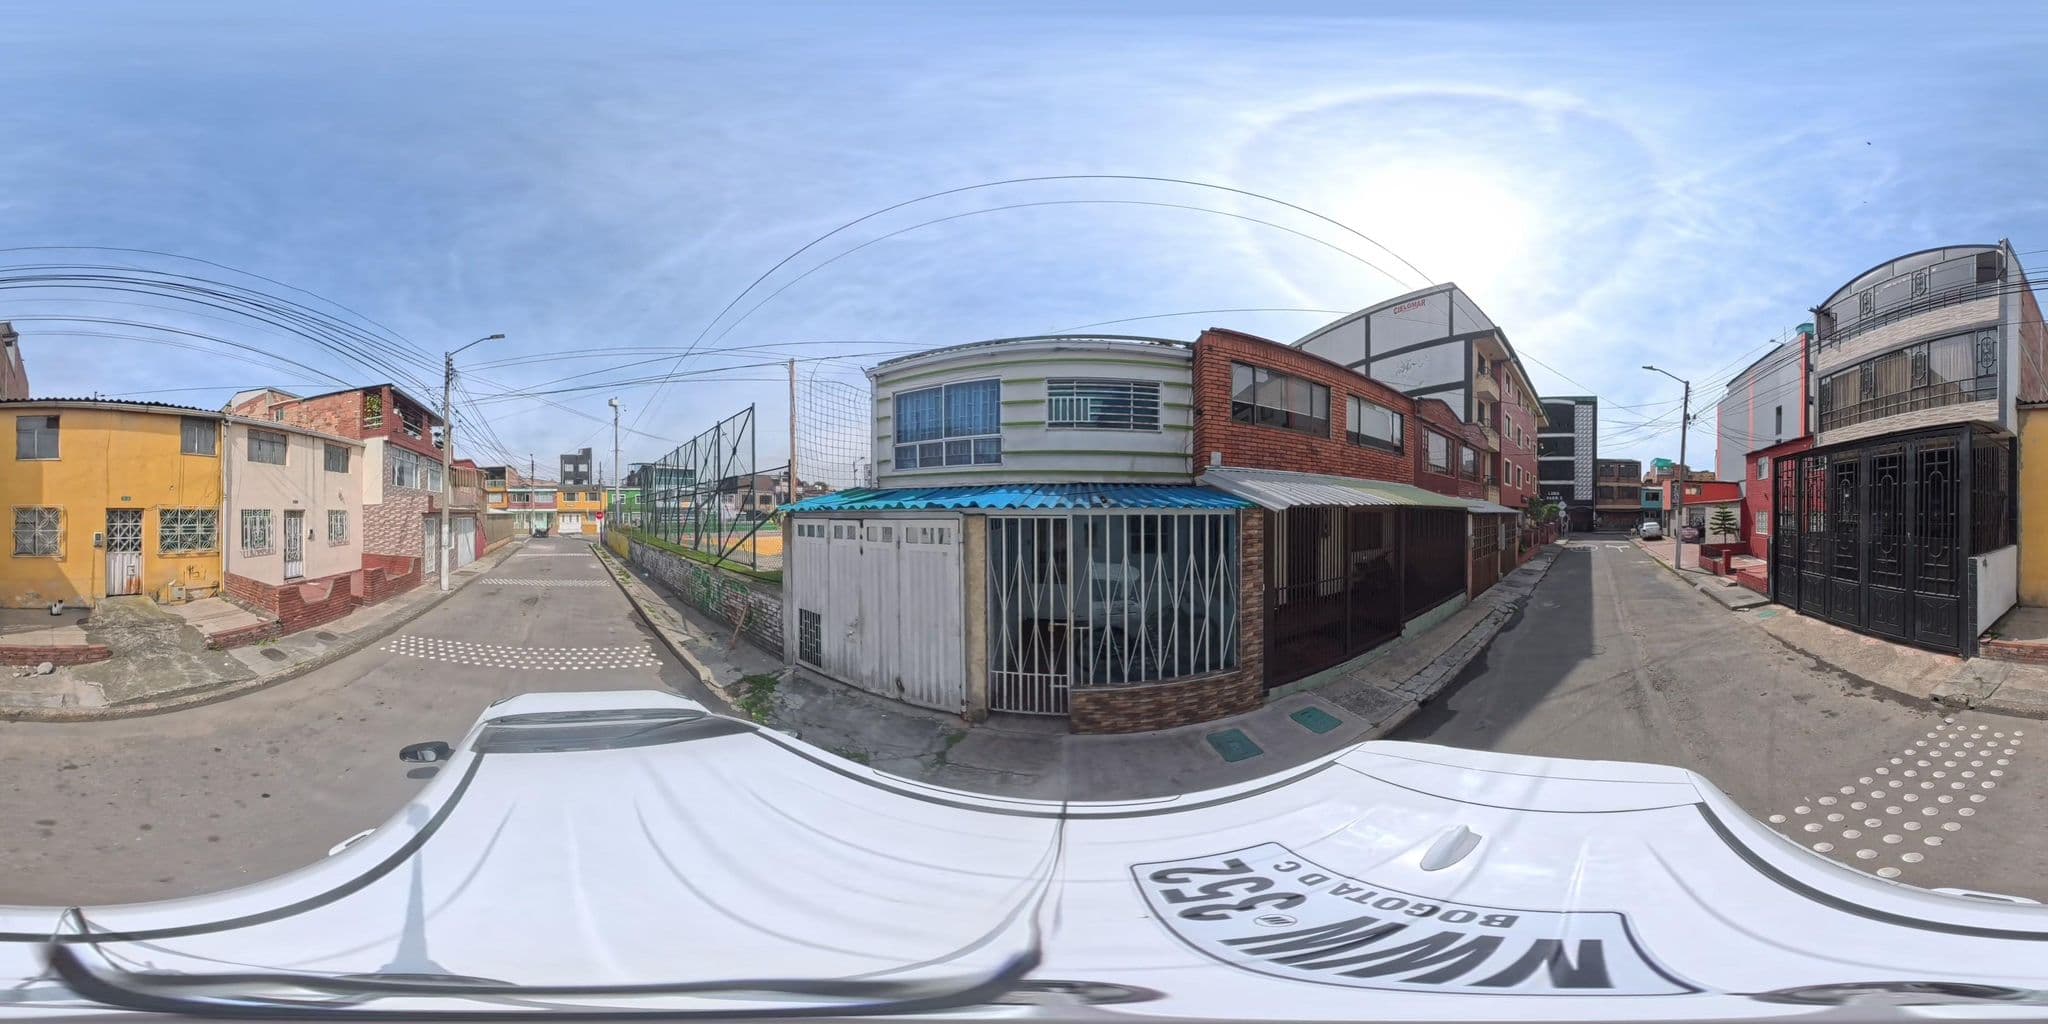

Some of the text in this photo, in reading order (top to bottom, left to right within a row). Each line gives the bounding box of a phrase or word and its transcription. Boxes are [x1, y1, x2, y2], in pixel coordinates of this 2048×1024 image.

[1150, 858, 1615, 988] NWW 352
[1273, 860, 1520, 928] BOGOTA D C
